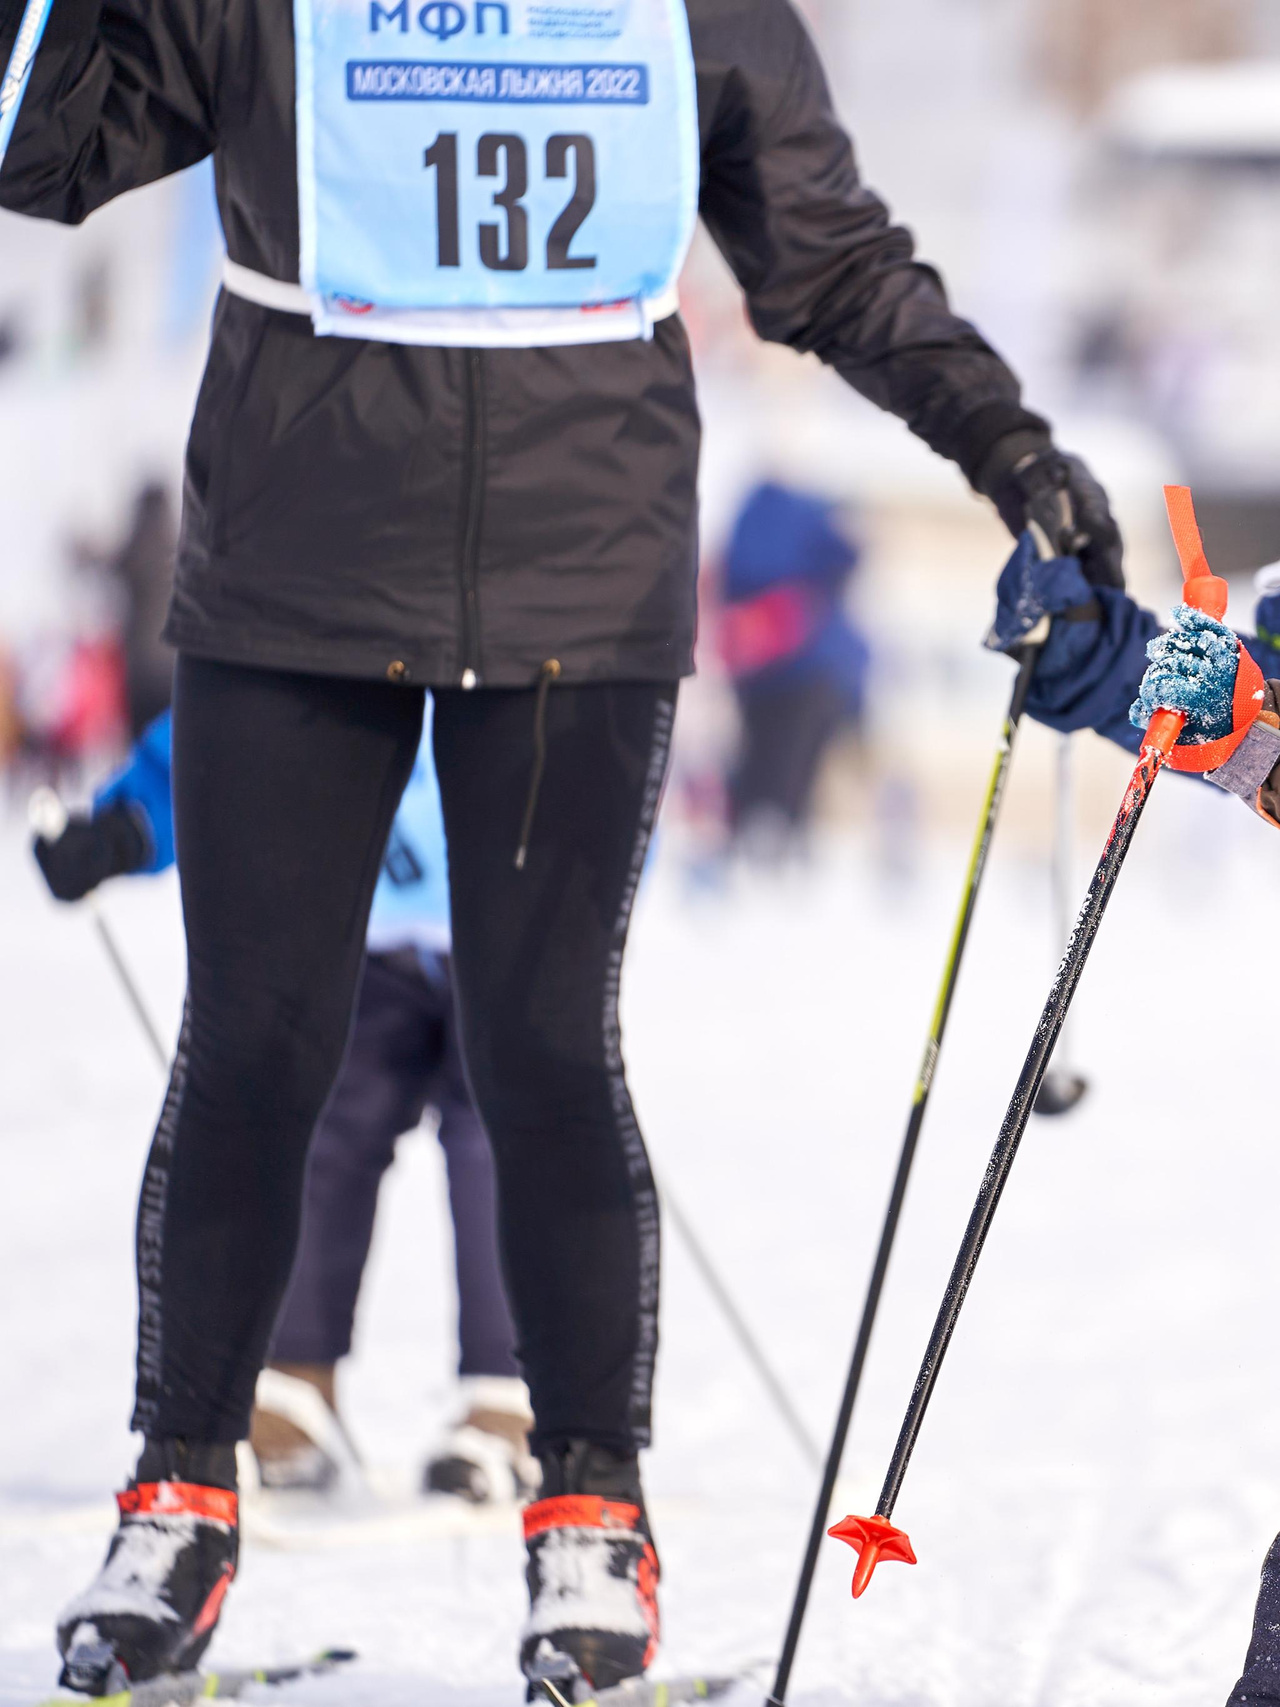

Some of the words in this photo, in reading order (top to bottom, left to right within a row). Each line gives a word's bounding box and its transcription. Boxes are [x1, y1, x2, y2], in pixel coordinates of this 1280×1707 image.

[370, 0, 509, 41] МФП
[352, 65, 497, 97] МОСКОВСКАЯ
[499, 68, 583, 98] ЛЫЖНЯ
[585, 69, 641, 98] 2022
[423, 130, 598, 271] 132
